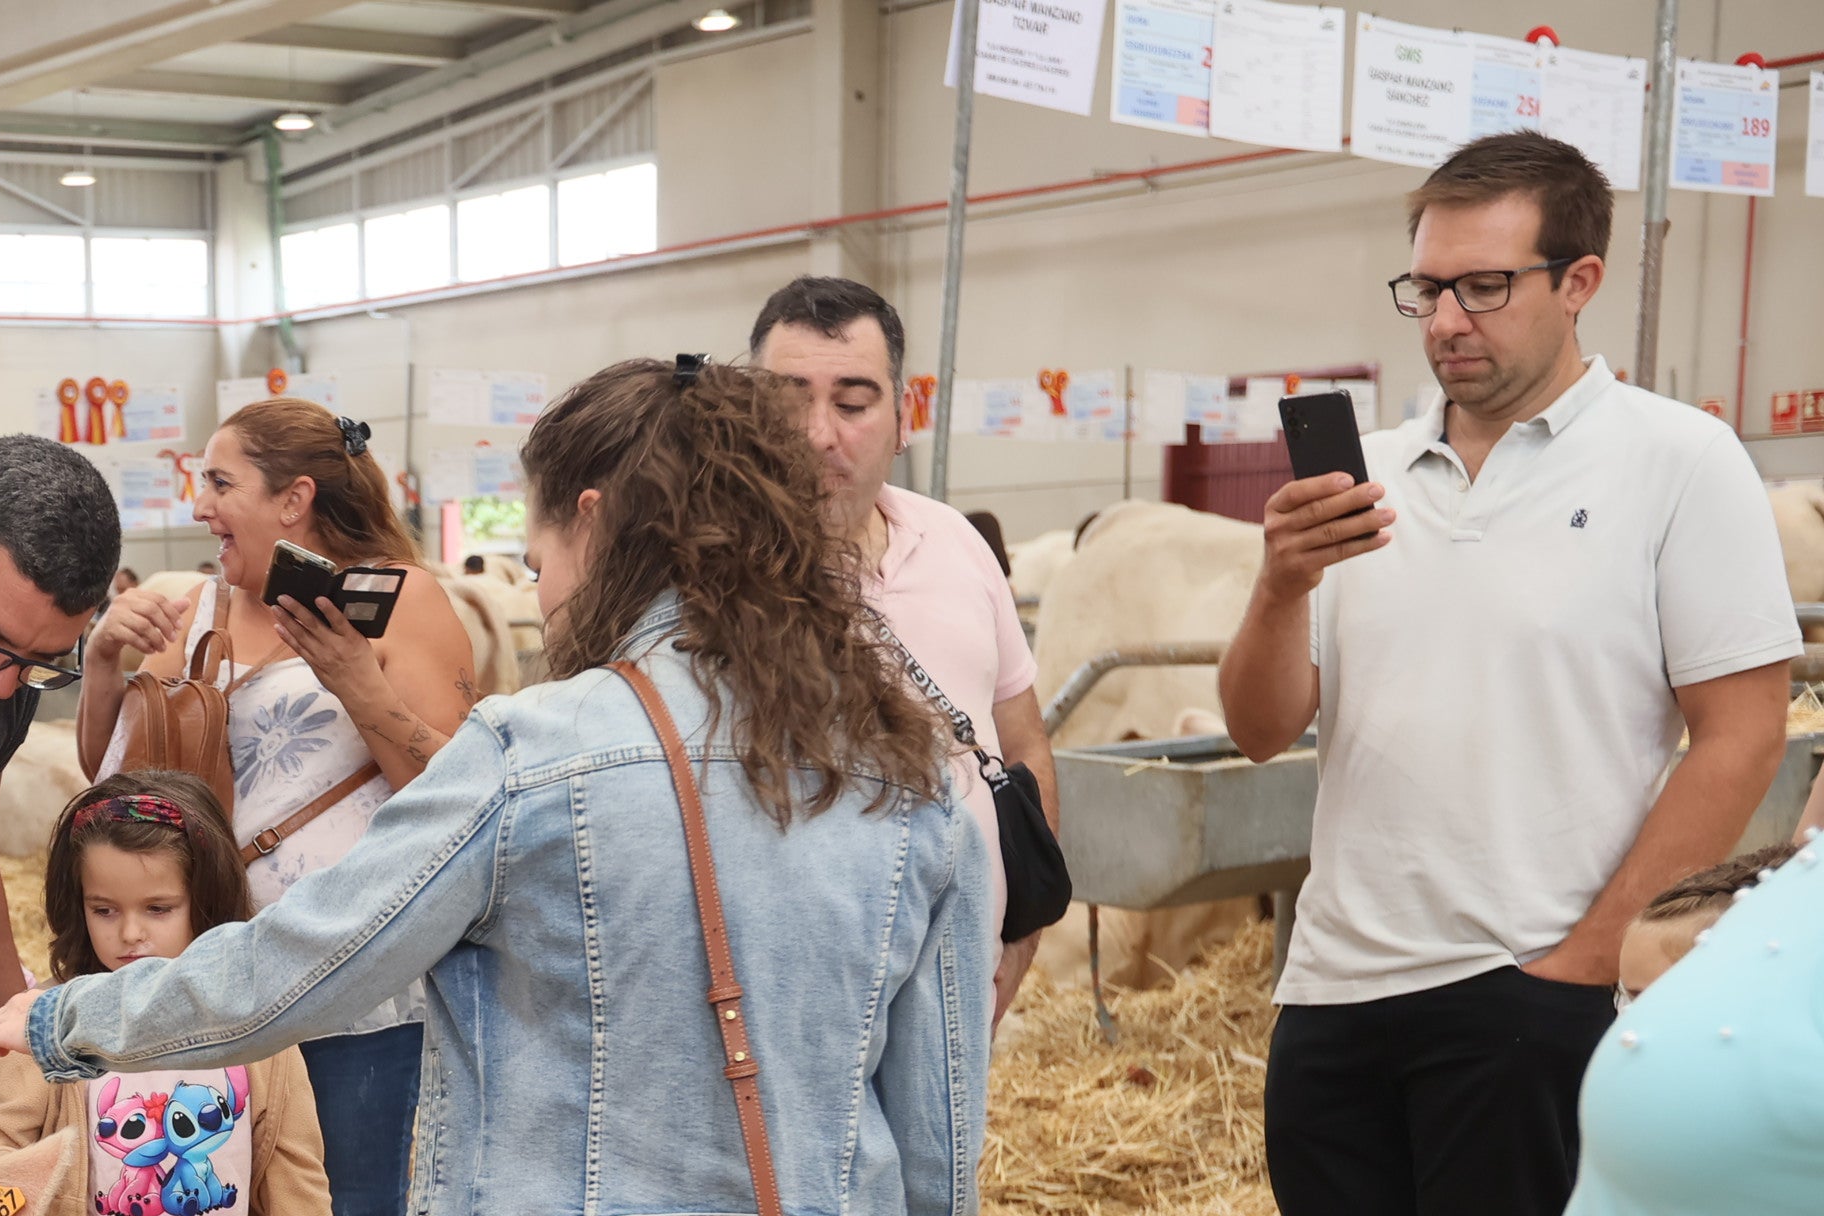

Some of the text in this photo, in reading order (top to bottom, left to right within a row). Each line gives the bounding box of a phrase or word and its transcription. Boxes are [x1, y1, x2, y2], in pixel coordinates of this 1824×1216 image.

[1030, 1, 1082, 25] MANZANO
[1405, 71, 1455, 93] MANZANO
[1742, 117, 1770, 138] 189
